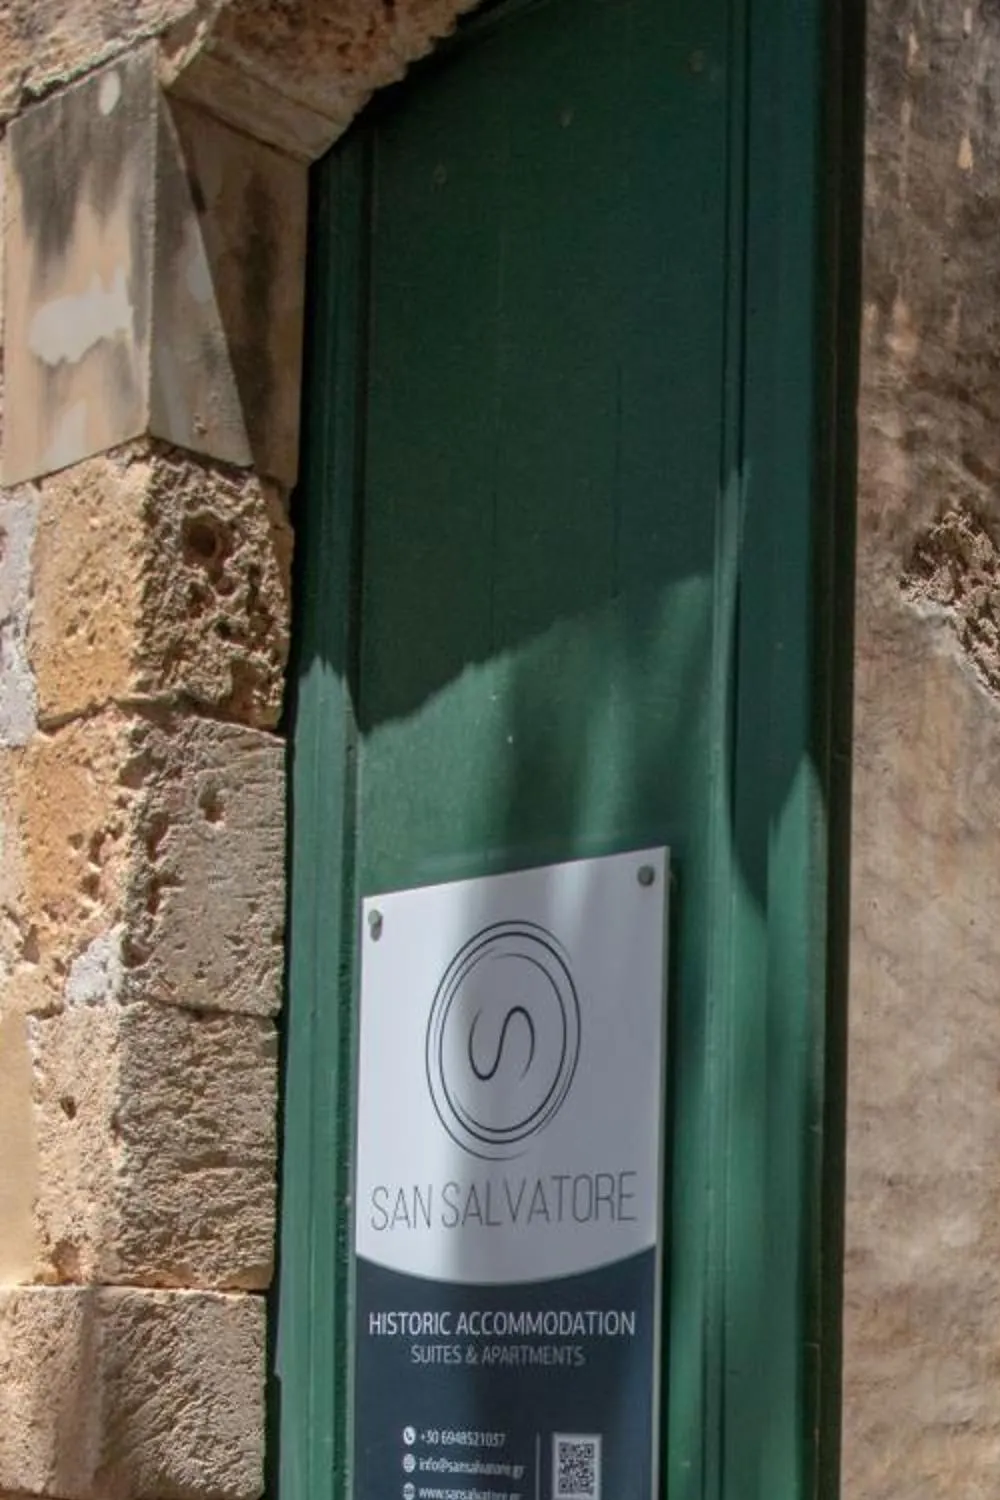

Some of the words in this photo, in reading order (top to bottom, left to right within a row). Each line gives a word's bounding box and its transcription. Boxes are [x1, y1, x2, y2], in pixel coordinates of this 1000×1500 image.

[370, 1183, 432, 1231] SAN
[441, 1171, 637, 1228] SALVATORE
[369, 1311, 451, 1336] HISTORIC
[456, 1310, 635, 1336] ACCOMMODATION
[410, 1344, 462, 1365] SUITES
[465, 1345, 479, 1365] &
[481, 1345, 586, 1367] APARTMENTS
